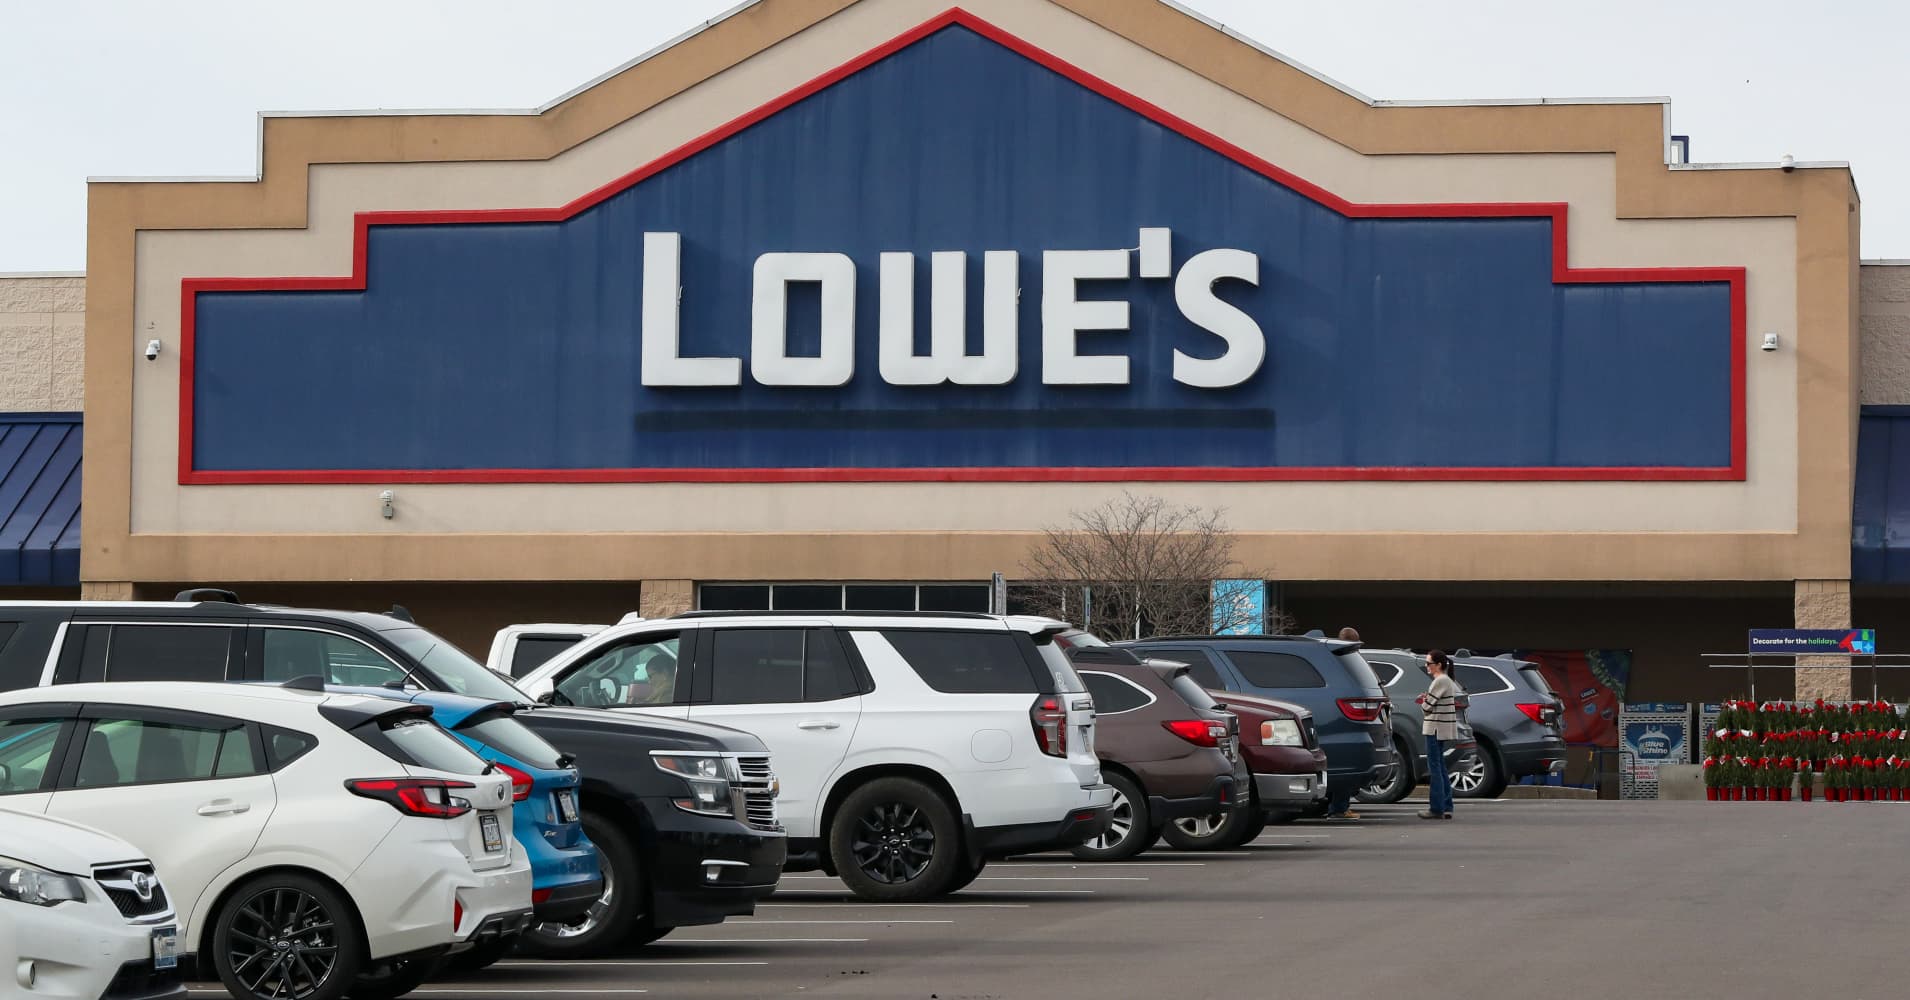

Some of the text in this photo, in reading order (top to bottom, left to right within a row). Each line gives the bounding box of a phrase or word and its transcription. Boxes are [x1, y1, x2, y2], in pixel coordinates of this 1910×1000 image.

[641, 227, 1266, 388] LOWE'S
[1753, 637, 1838, 646] Decorate for the holidays.
